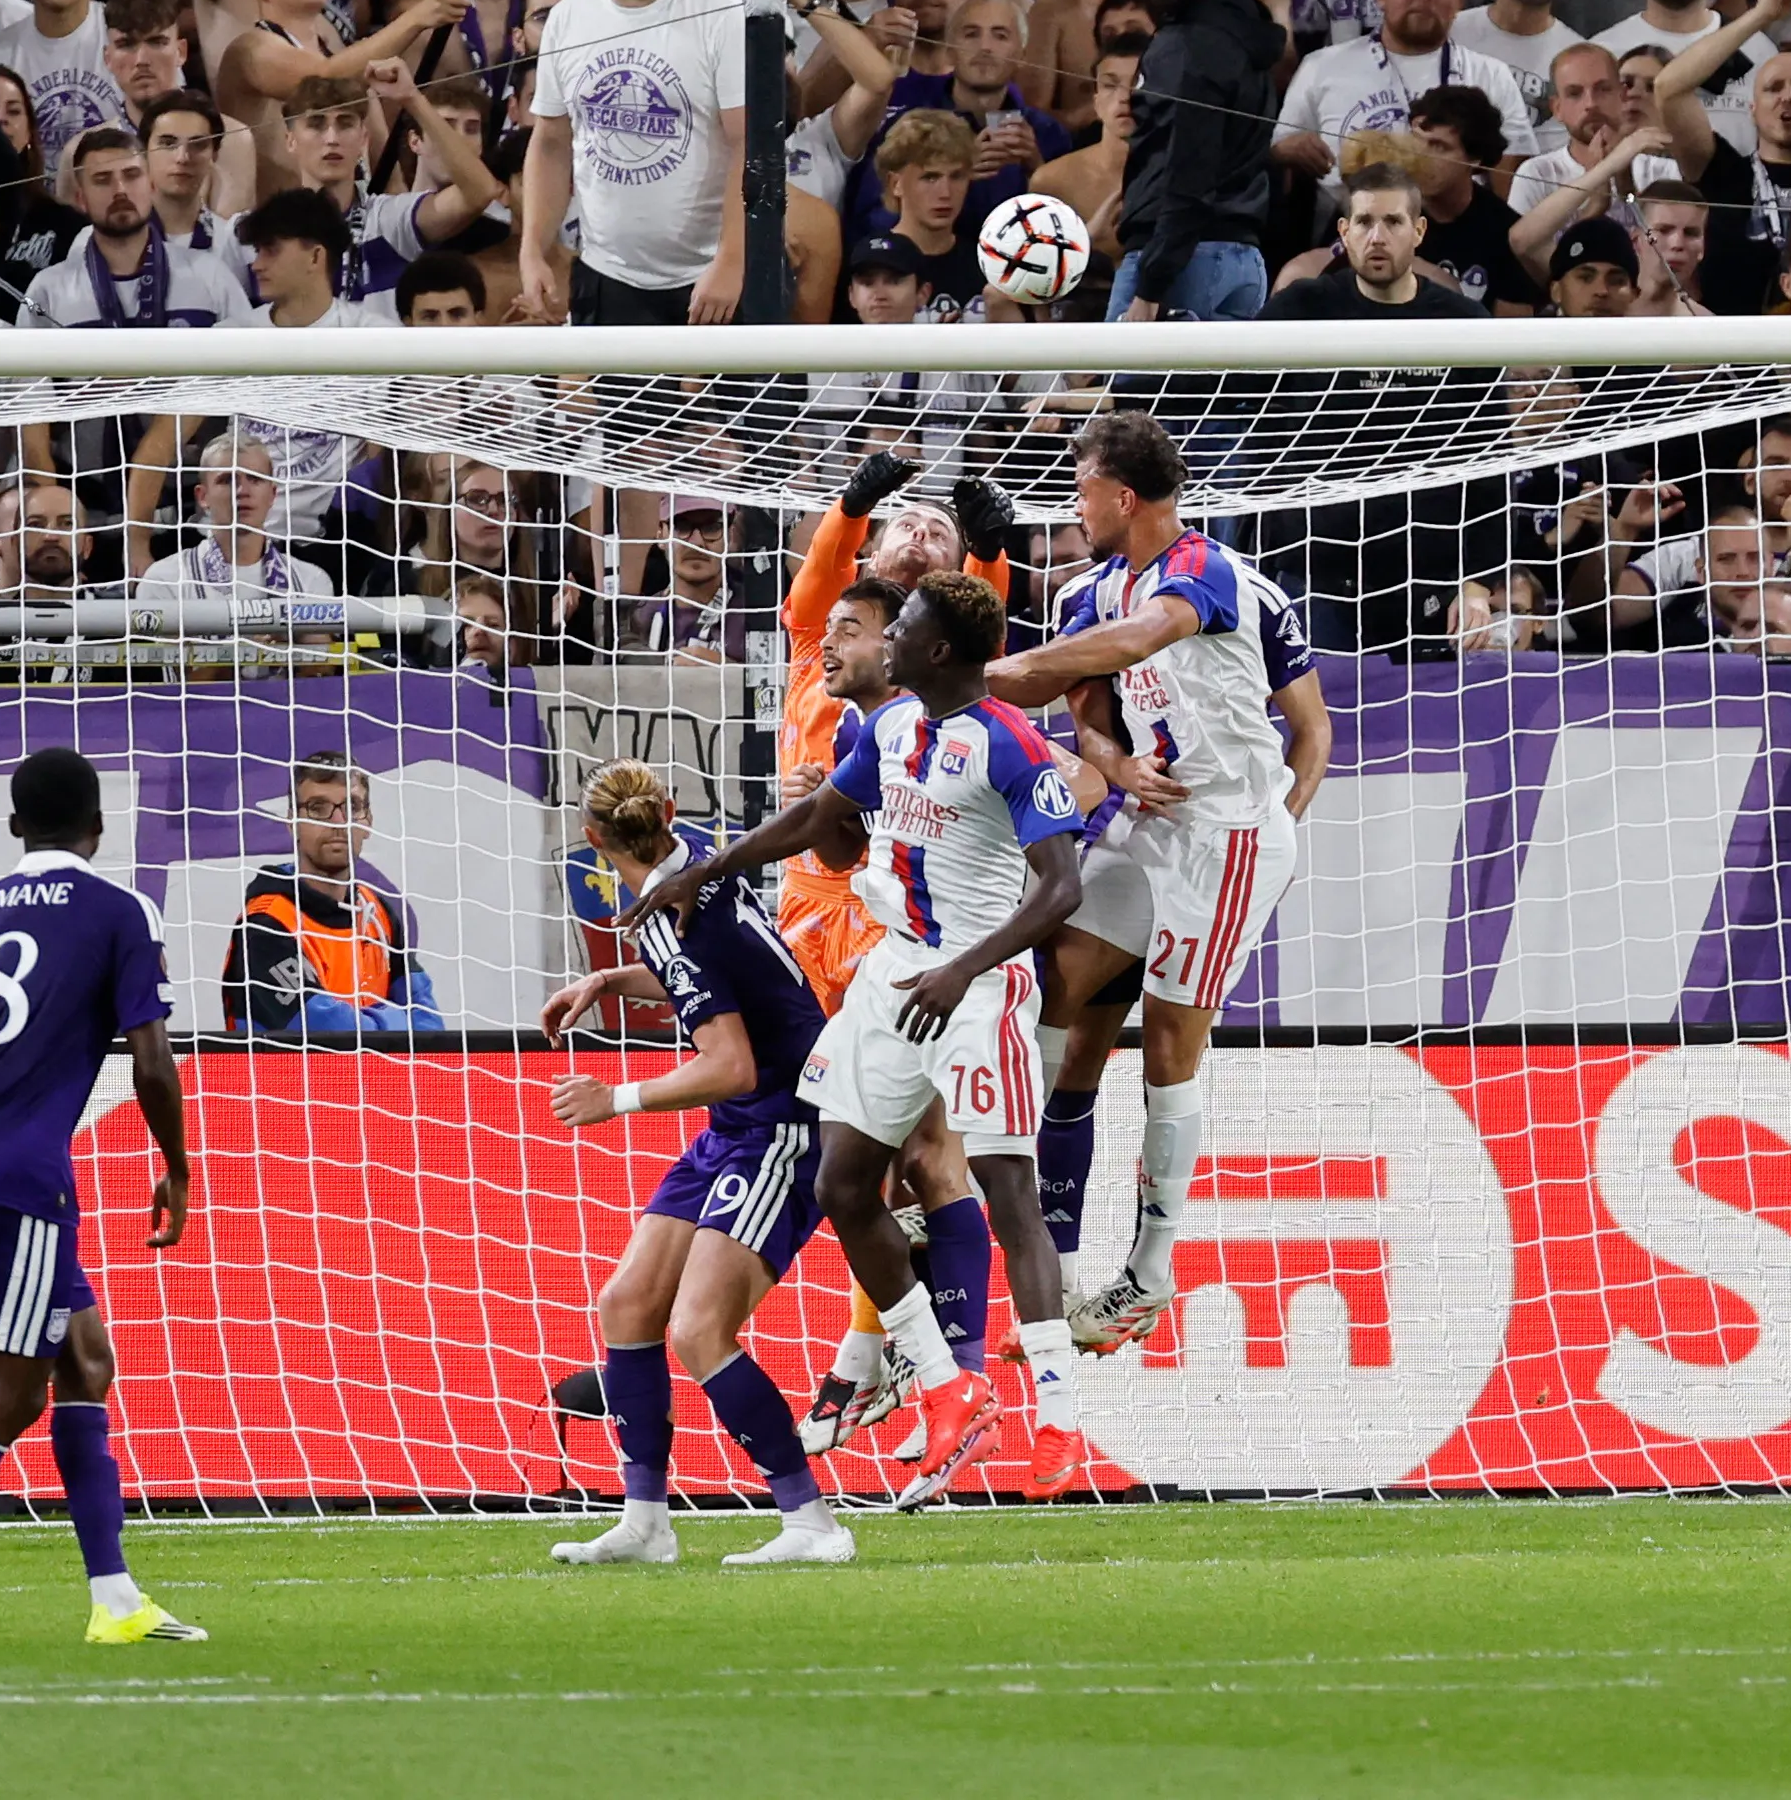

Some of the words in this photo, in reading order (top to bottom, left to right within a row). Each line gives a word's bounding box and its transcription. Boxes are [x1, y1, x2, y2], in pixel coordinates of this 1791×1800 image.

[31, 68, 116, 101] NDERLECHT
[586, 48, 681, 87] ANDERLECHT
[638, 115, 677, 136] FANS
[584, 138, 688, 186] INTERNATIONAL
[1037, 780, 1075, 815] MG
[899, 809, 944, 840] BETTER
[1148, 929, 1200, 986] 21
[951, 1064, 996, 1115] 76
